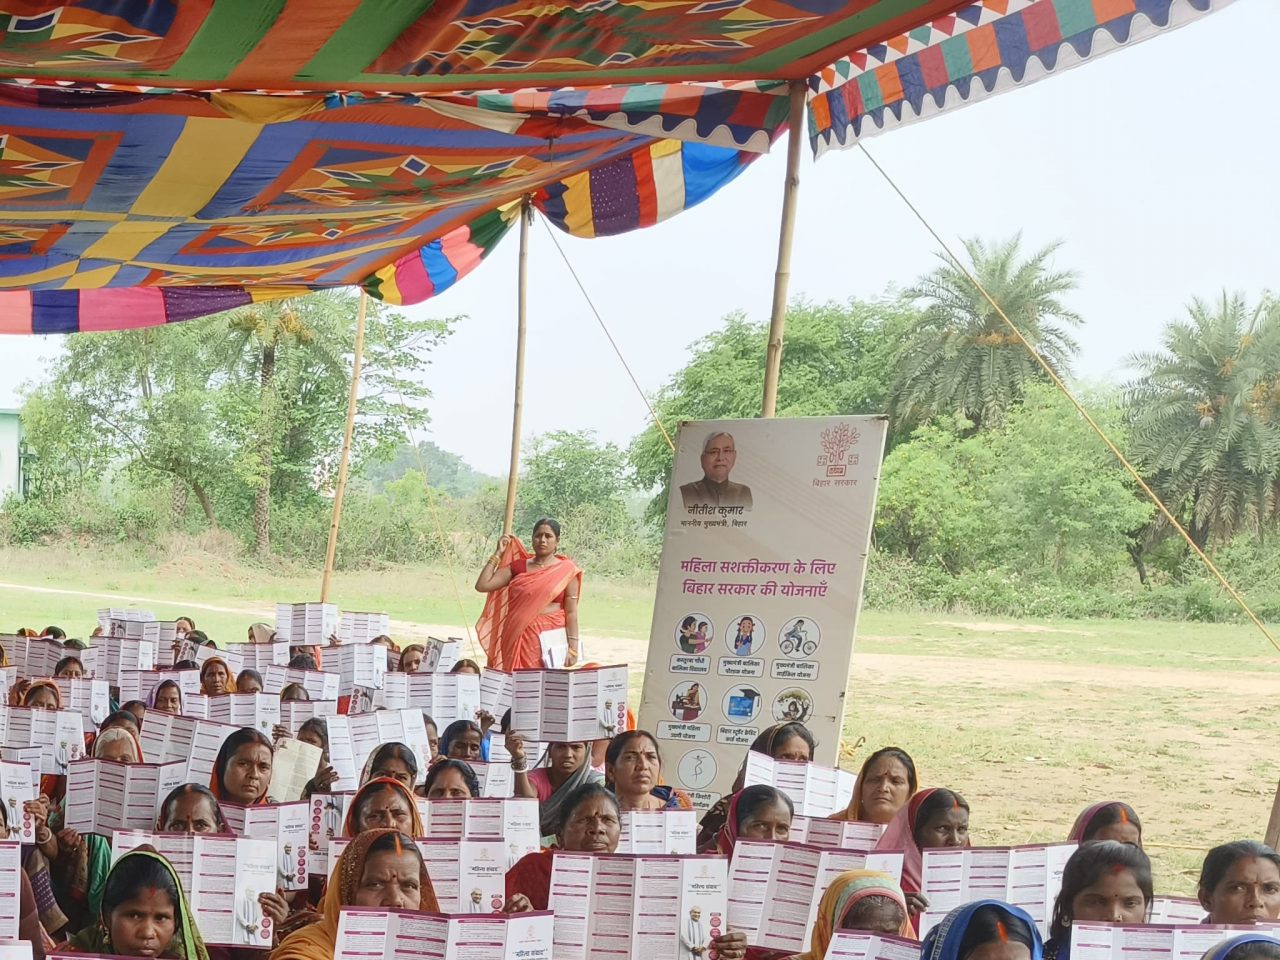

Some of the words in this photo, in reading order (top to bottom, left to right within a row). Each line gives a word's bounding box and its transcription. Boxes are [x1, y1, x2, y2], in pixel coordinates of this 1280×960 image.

[687, 503, 716, 515] नीतीश
[718, 505, 745, 518] कुमार
[681, 557, 717, 573] महिला
[720, 558, 791, 574] सशक्तीकरण
[793, 559, 807, 574] के
[810, 559, 836, 574] लिए
[682, 578, 715, 594] बिहार
[717, 583, 757, 595] सरकार
[760, 581, 778, 596] की
[780, 580, 828, 597] योजनाएँ
